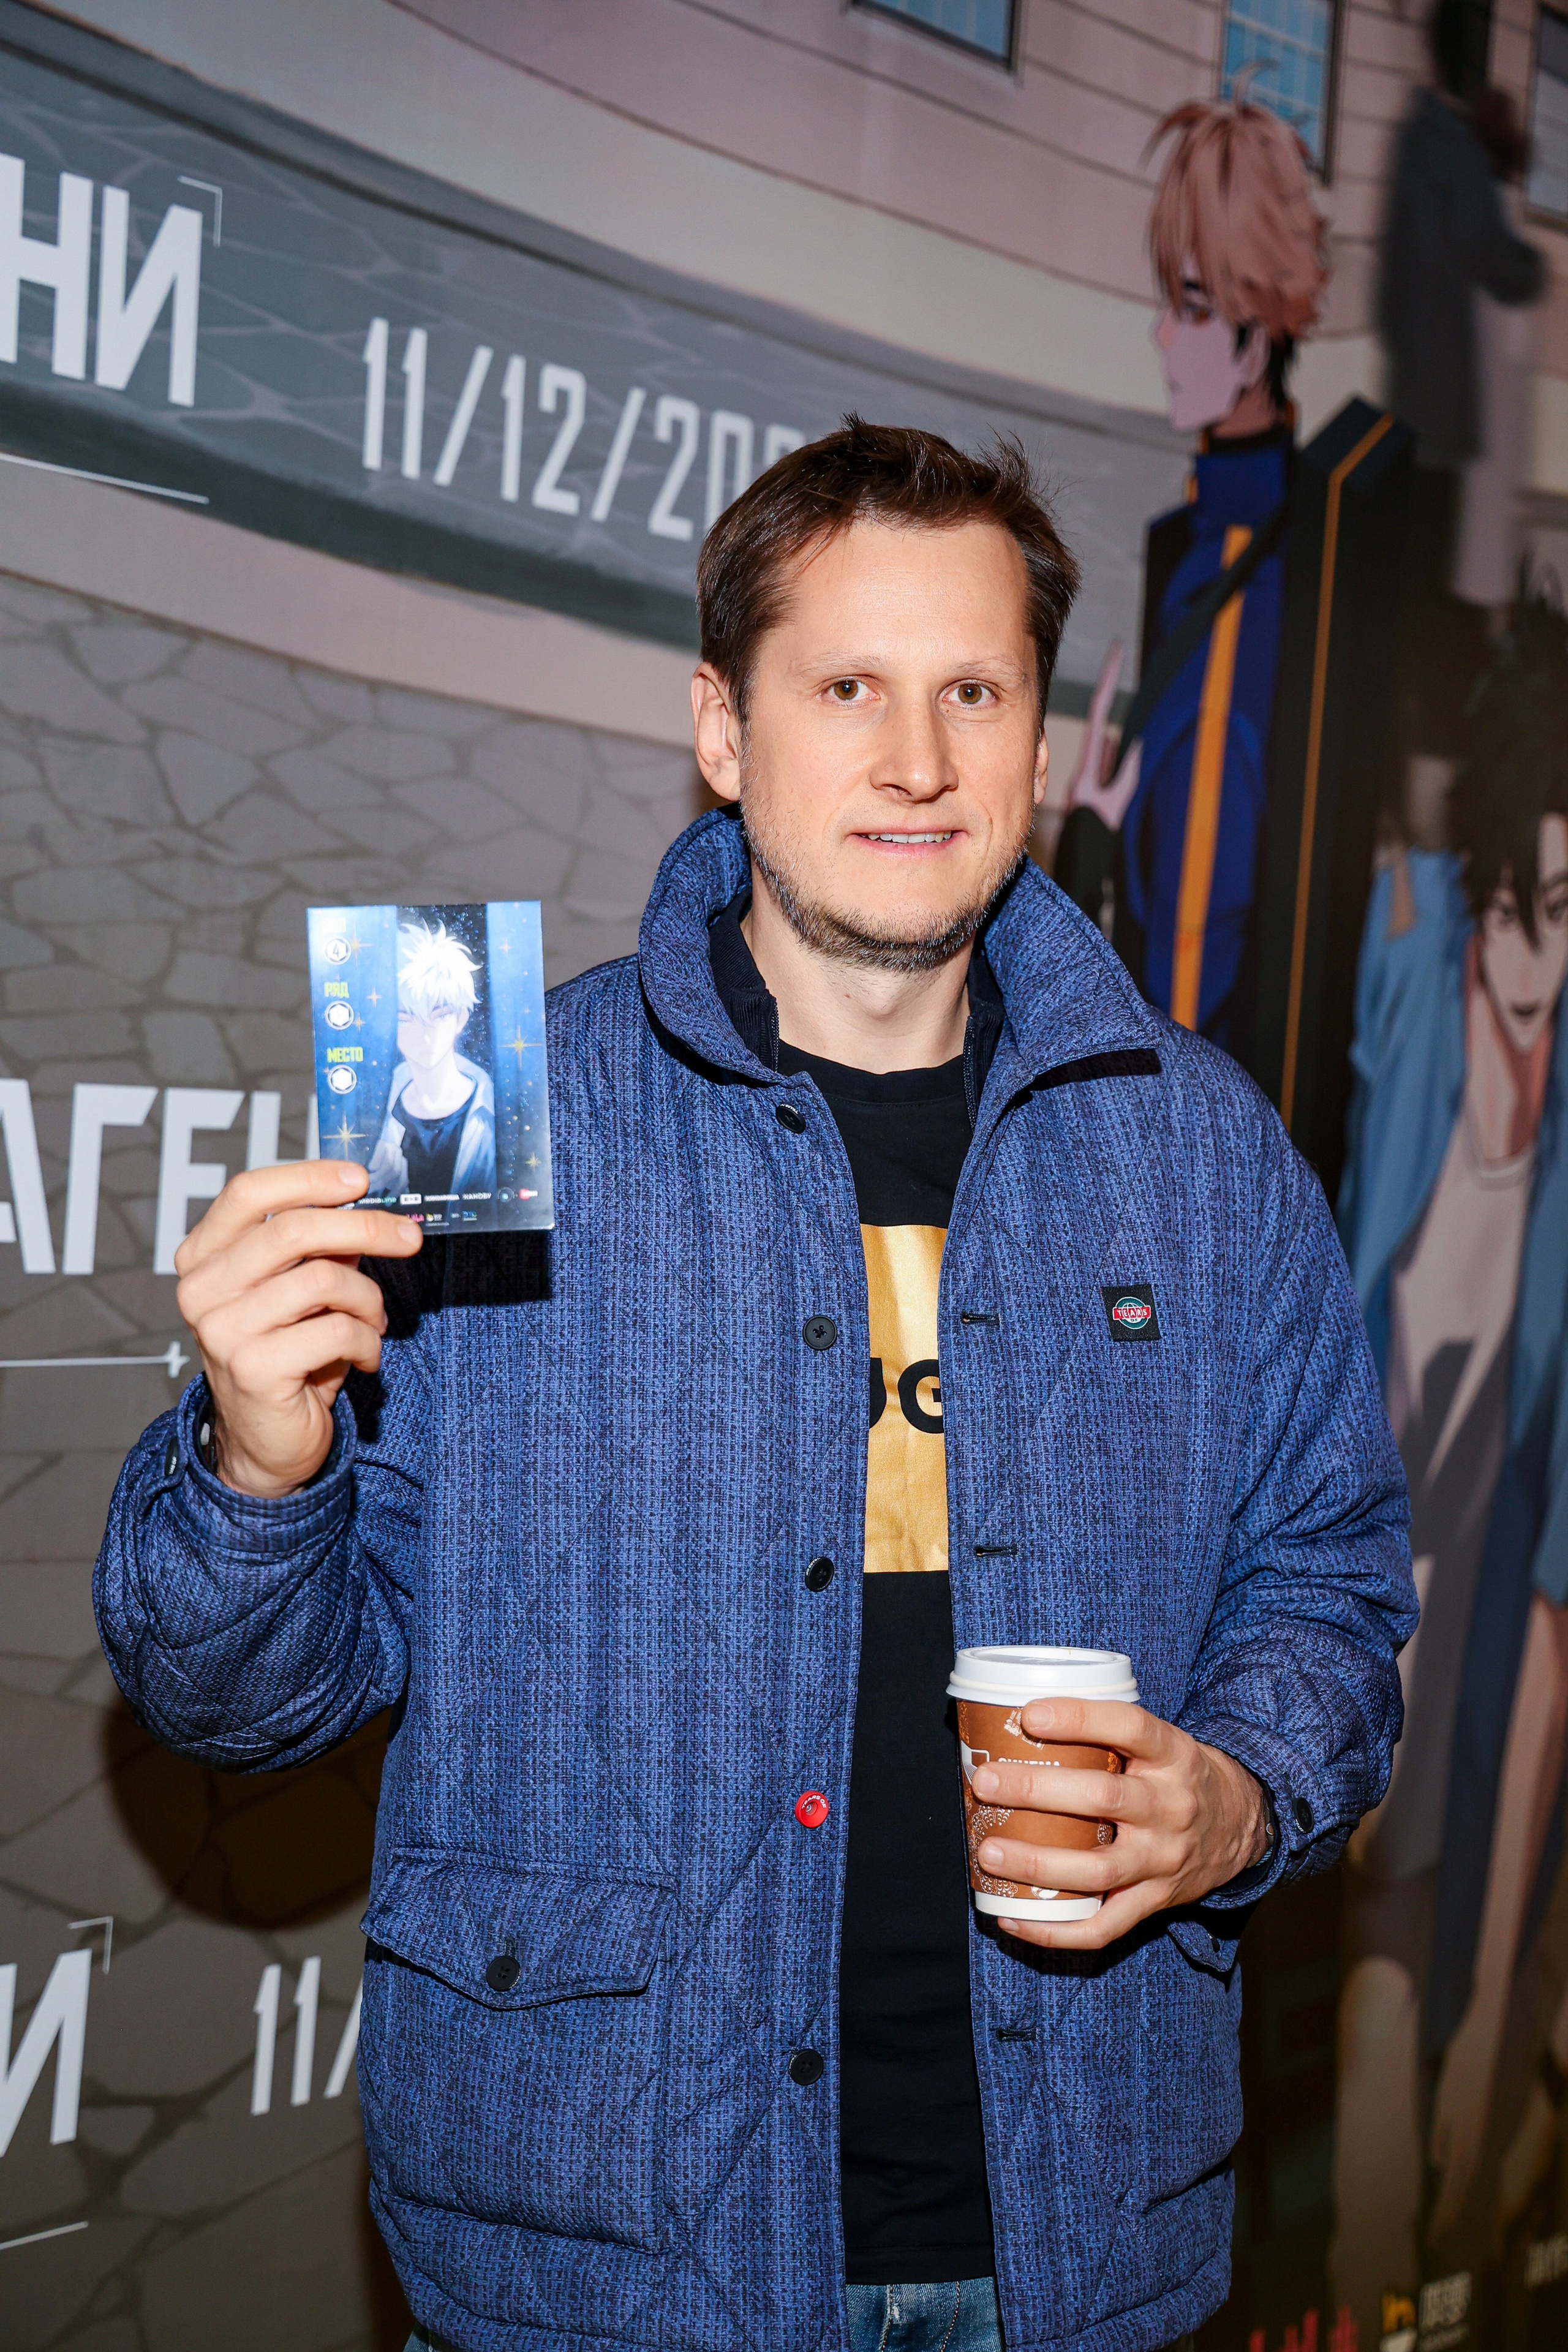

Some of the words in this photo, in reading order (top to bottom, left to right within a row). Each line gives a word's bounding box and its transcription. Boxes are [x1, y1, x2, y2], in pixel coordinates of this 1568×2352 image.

[324, 982, 349, 998] РЯД
[326, 1046, 364, 1063] МЕСТО
[1117, 1308, 1148, 1317] TEARS
[801, 1795, 821, 1809] TEARS
[820, 1798, 827, 1808] OF
